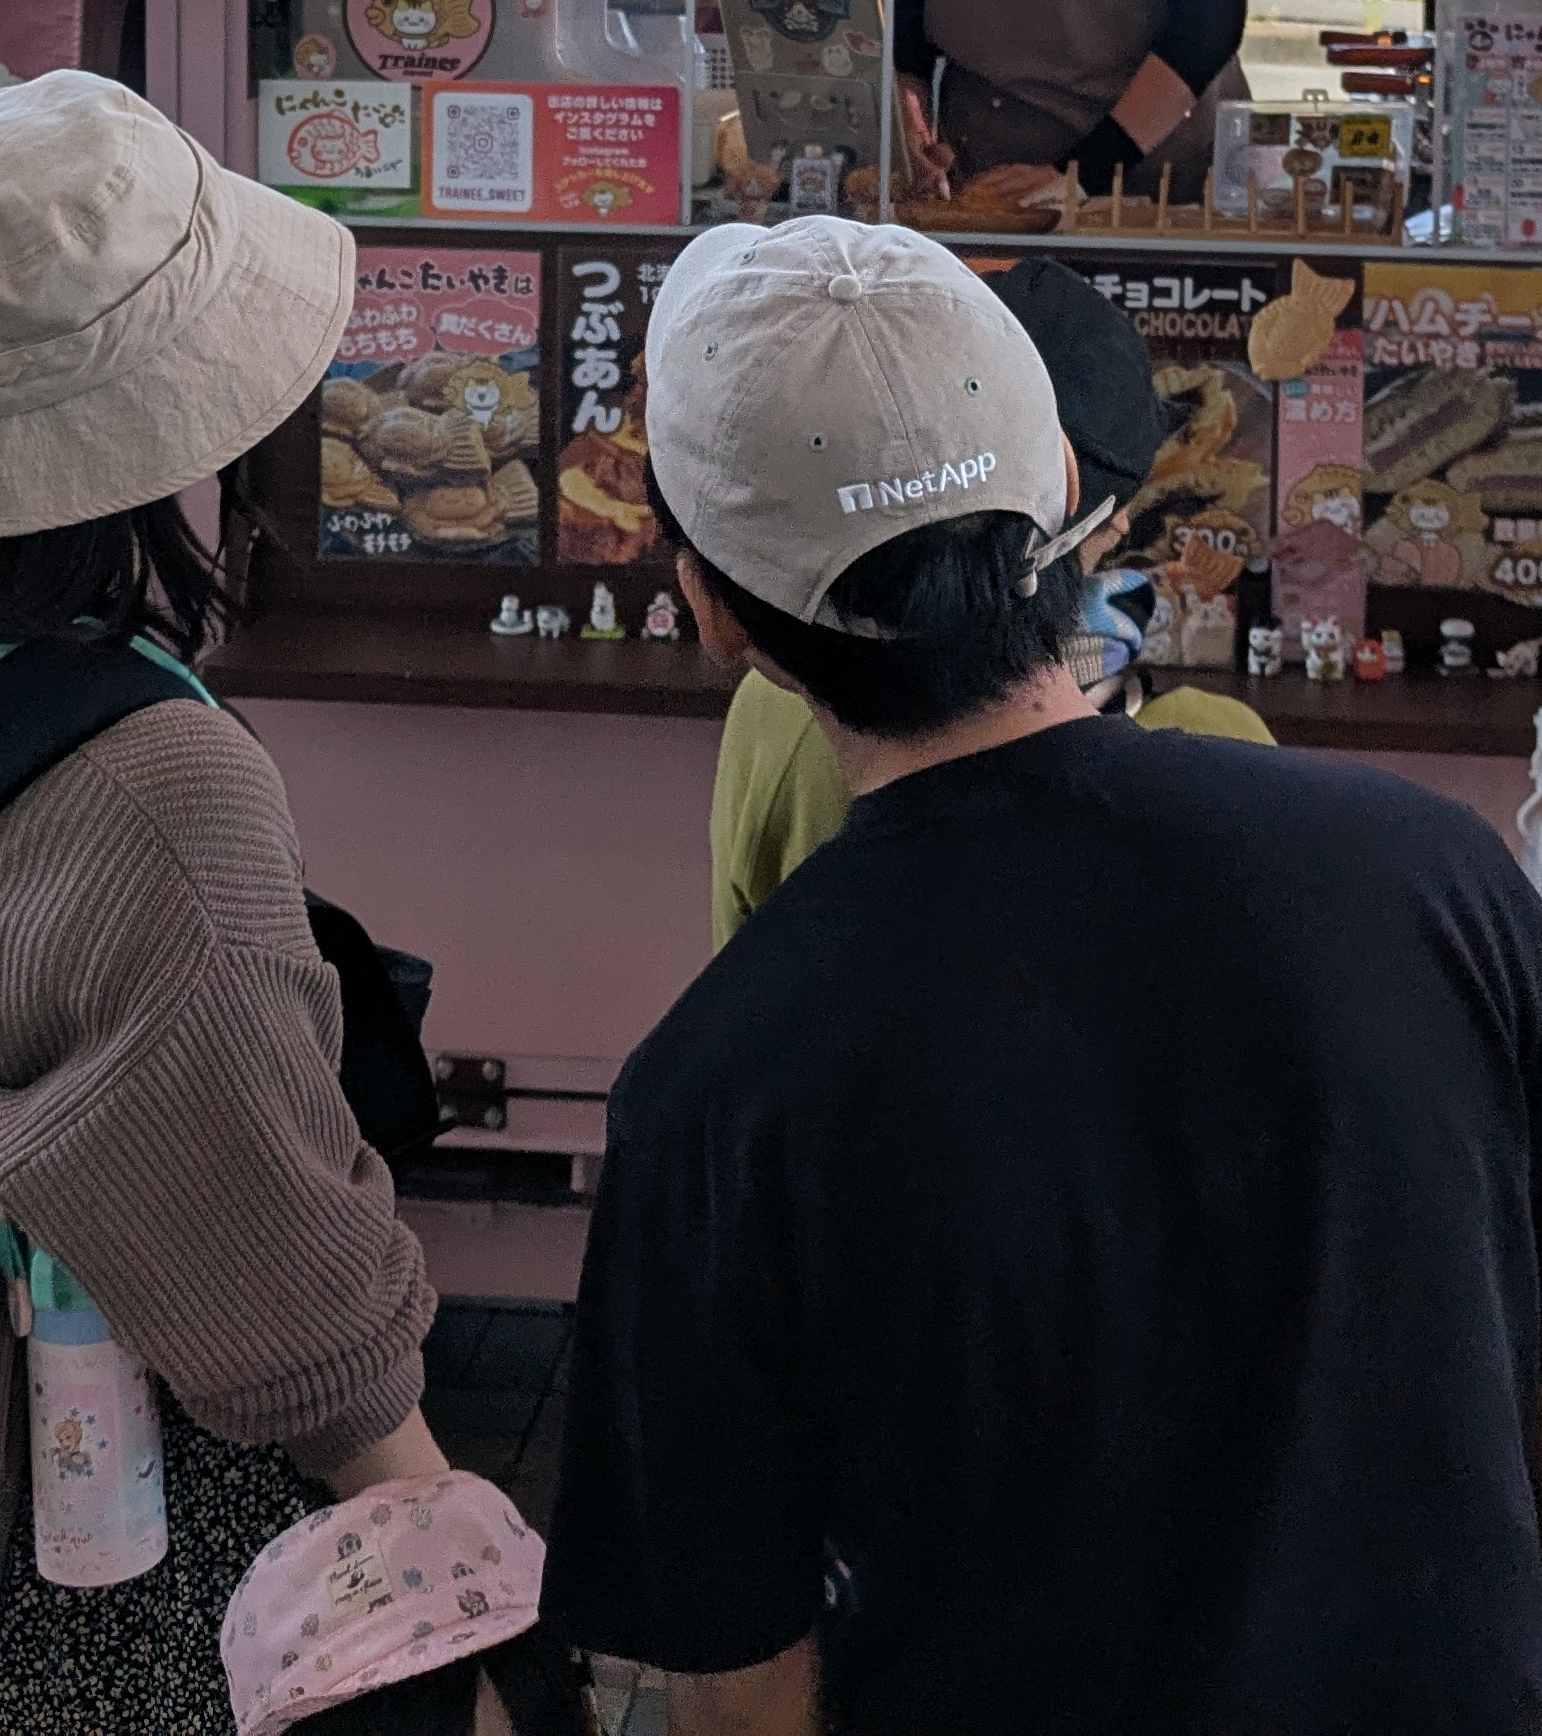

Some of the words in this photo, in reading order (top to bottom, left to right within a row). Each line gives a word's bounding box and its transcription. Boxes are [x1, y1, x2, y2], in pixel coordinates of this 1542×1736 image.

[378, 52, 462, 72] Trainee
[553, 111, 658, 128] インスタグラムを
[438, 185, 526, 203] TRAINEE_SWEET
[1083, 272, 1267, 313] チョコレート
[572, 260, 623, 435] つぶあん
[1373, 339, 1481, 369] たいやき
[878, 450, 997, 506] NetApp
